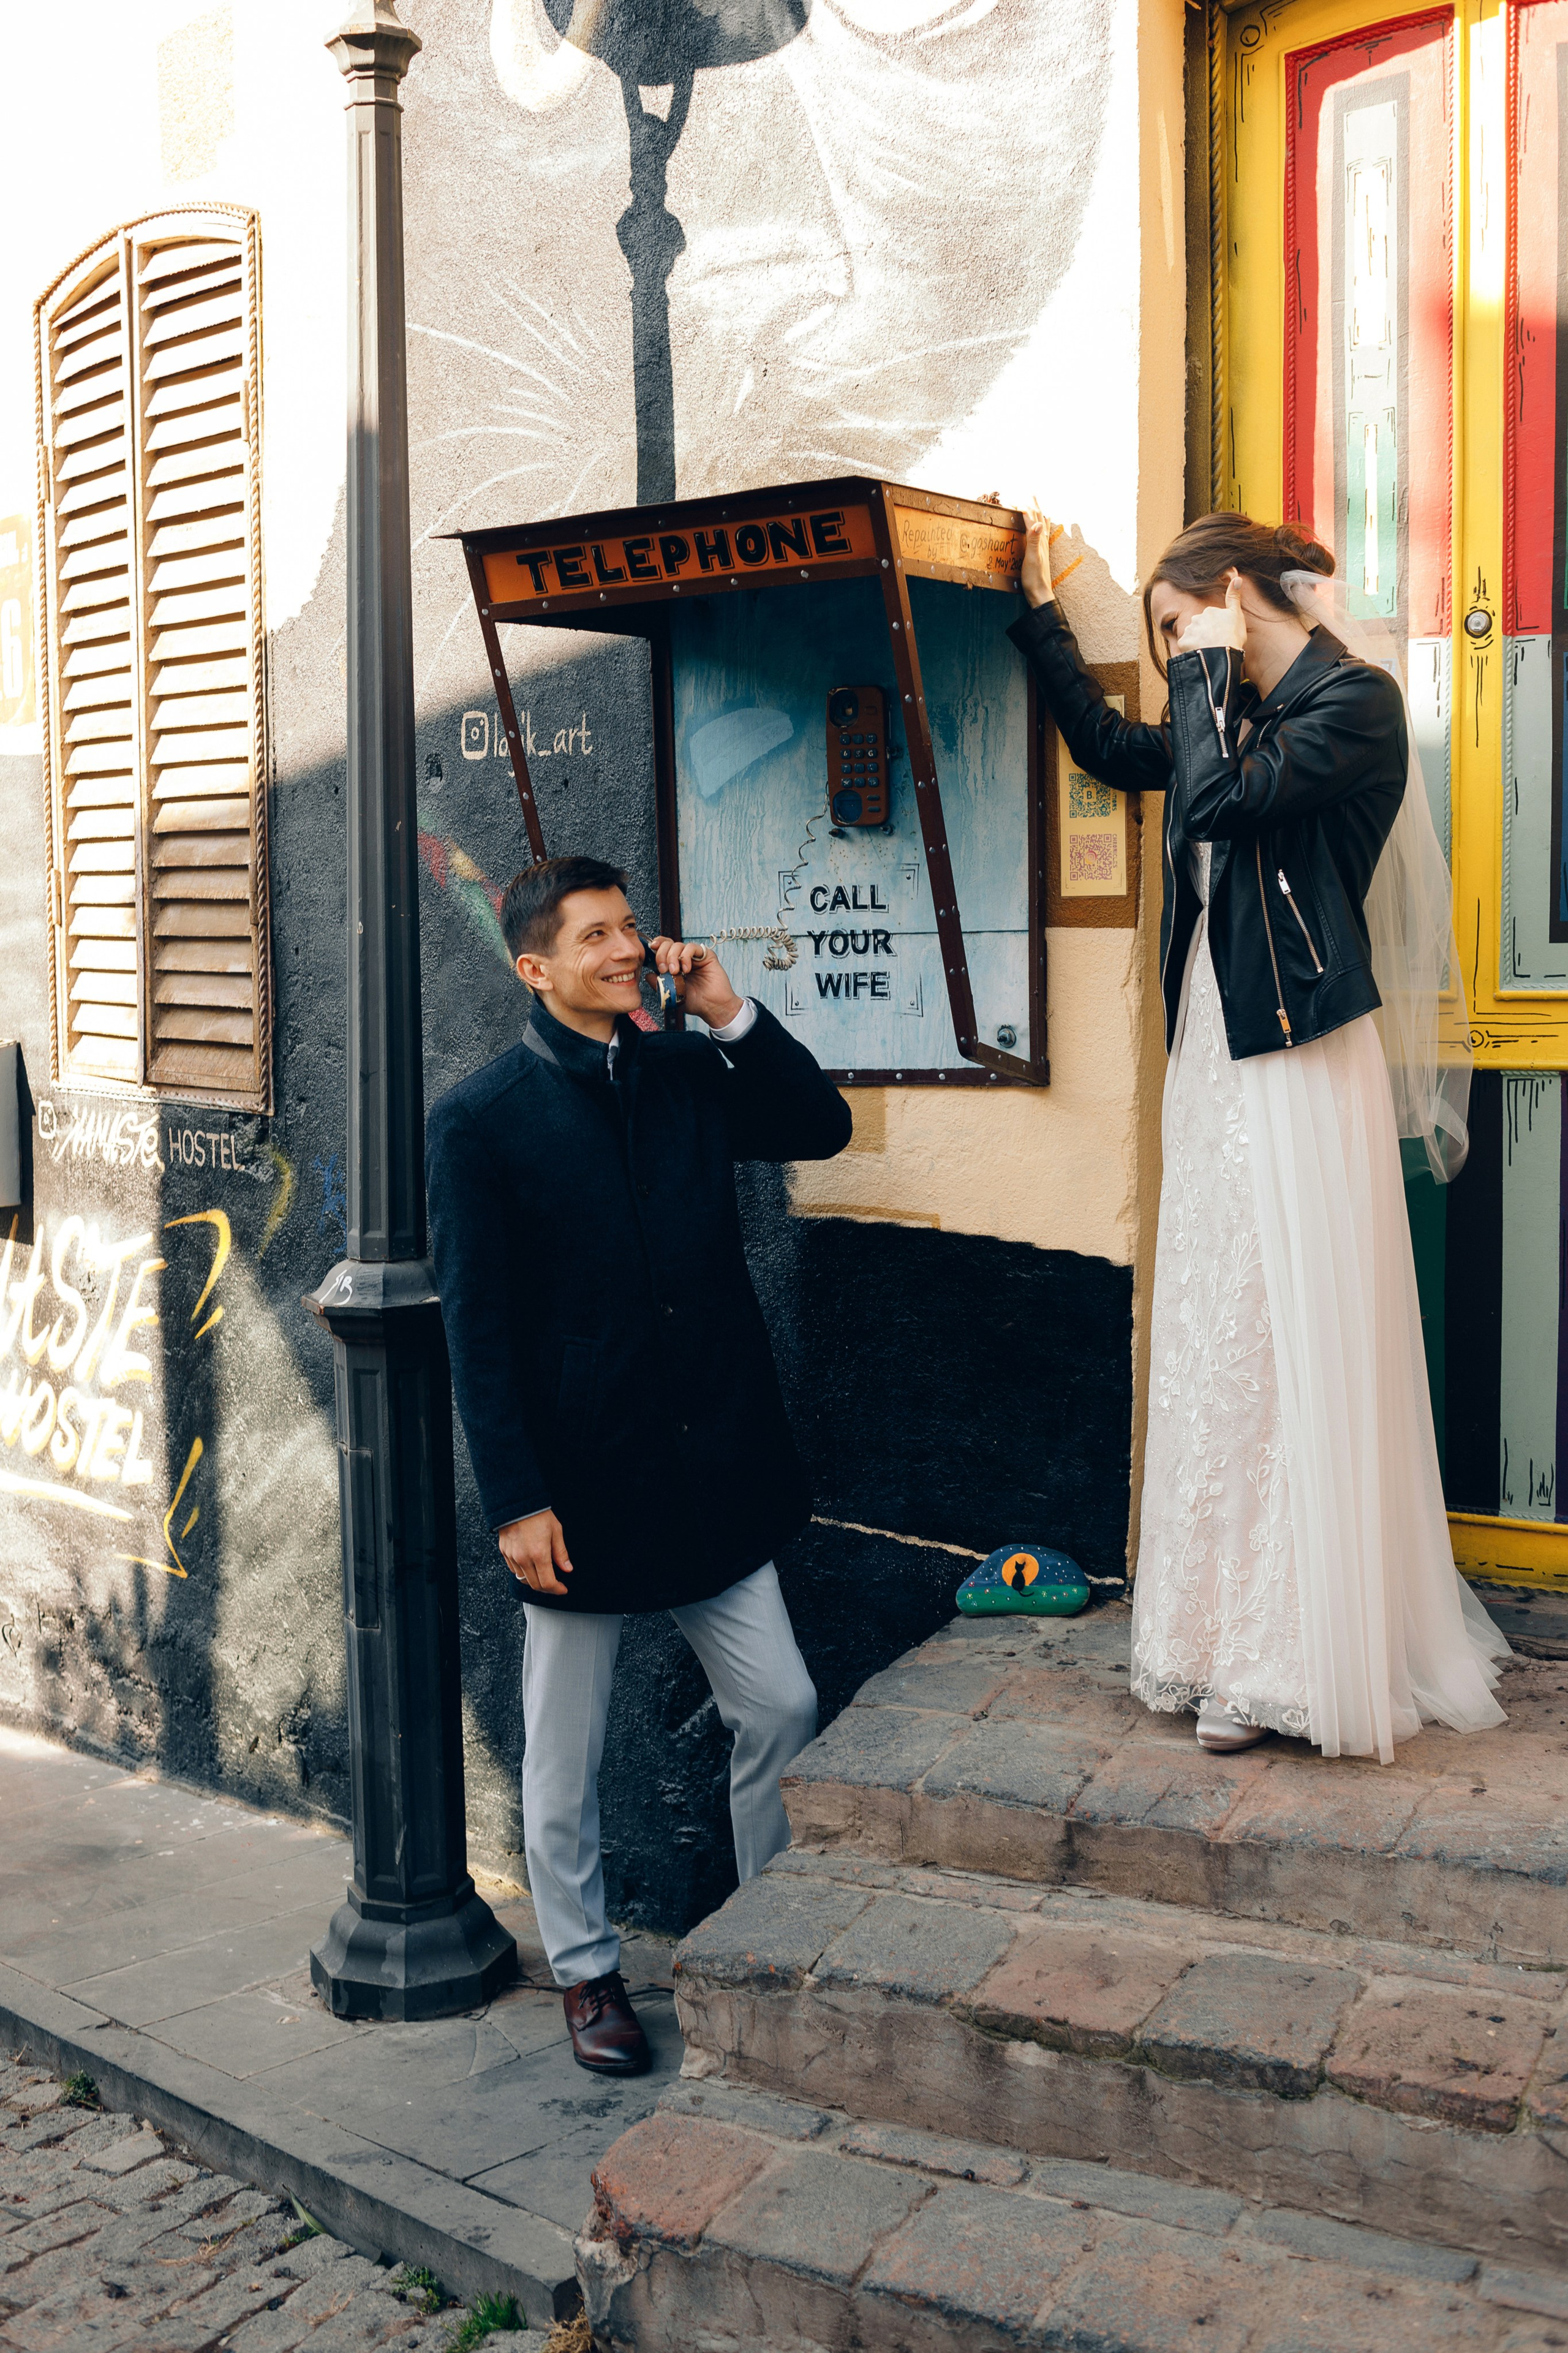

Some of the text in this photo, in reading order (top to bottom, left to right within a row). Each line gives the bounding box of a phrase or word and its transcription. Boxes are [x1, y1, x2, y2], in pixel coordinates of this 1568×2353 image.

[902, 519, 953, 550] Repainted
[516, 510, 853, 595] TELEPHONE
[927, 545, 938, 559] by
[810, 884, 889, 915] CALL
[807, 929, 898, 959] YOUR
[815, 971, 891, 1000] WIFE
[169, 1127, 246, 1171] HOSTEL
